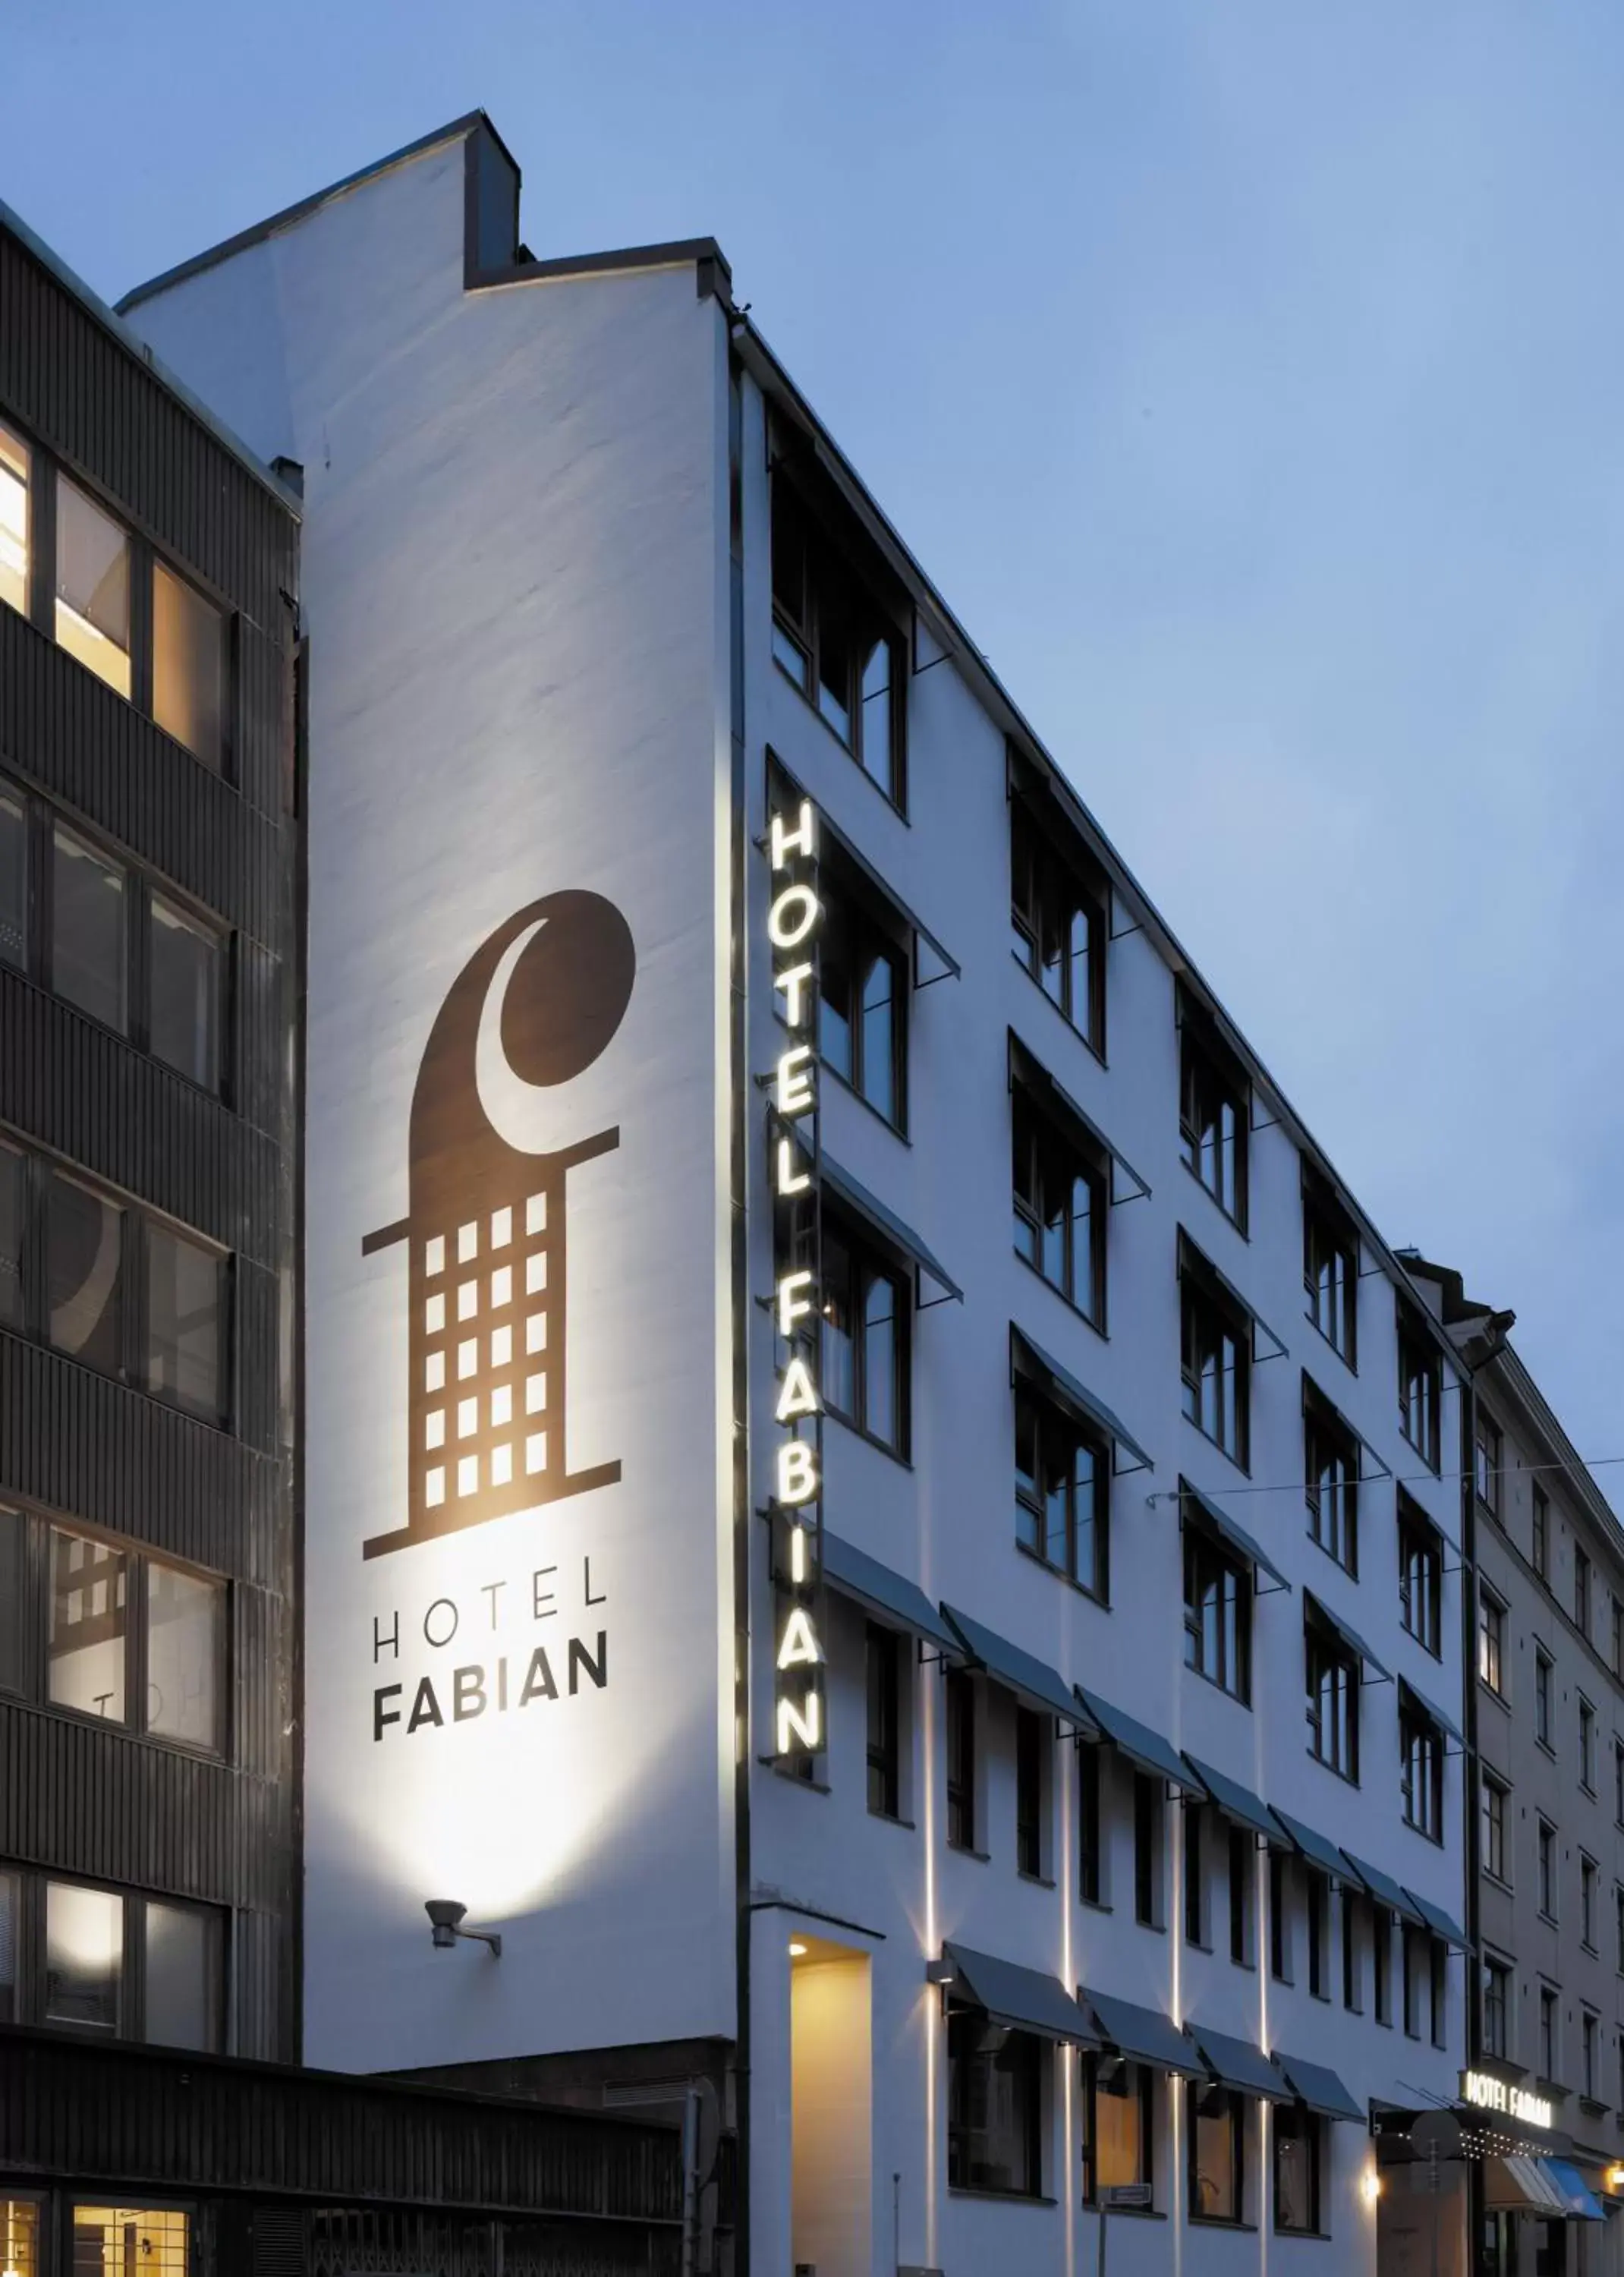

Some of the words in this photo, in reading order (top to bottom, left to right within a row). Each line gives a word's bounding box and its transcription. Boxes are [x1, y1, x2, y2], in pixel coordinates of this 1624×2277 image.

[767, 798, 819, 1196] HOTEL
[775, 1270, 820, 1754] FABIAN
[374, 1556, 607, 1664] HOTEL
[374, 1630, 607, 1742] FABIAN
[1466, 2070, 1506, 2112] HOTEL
